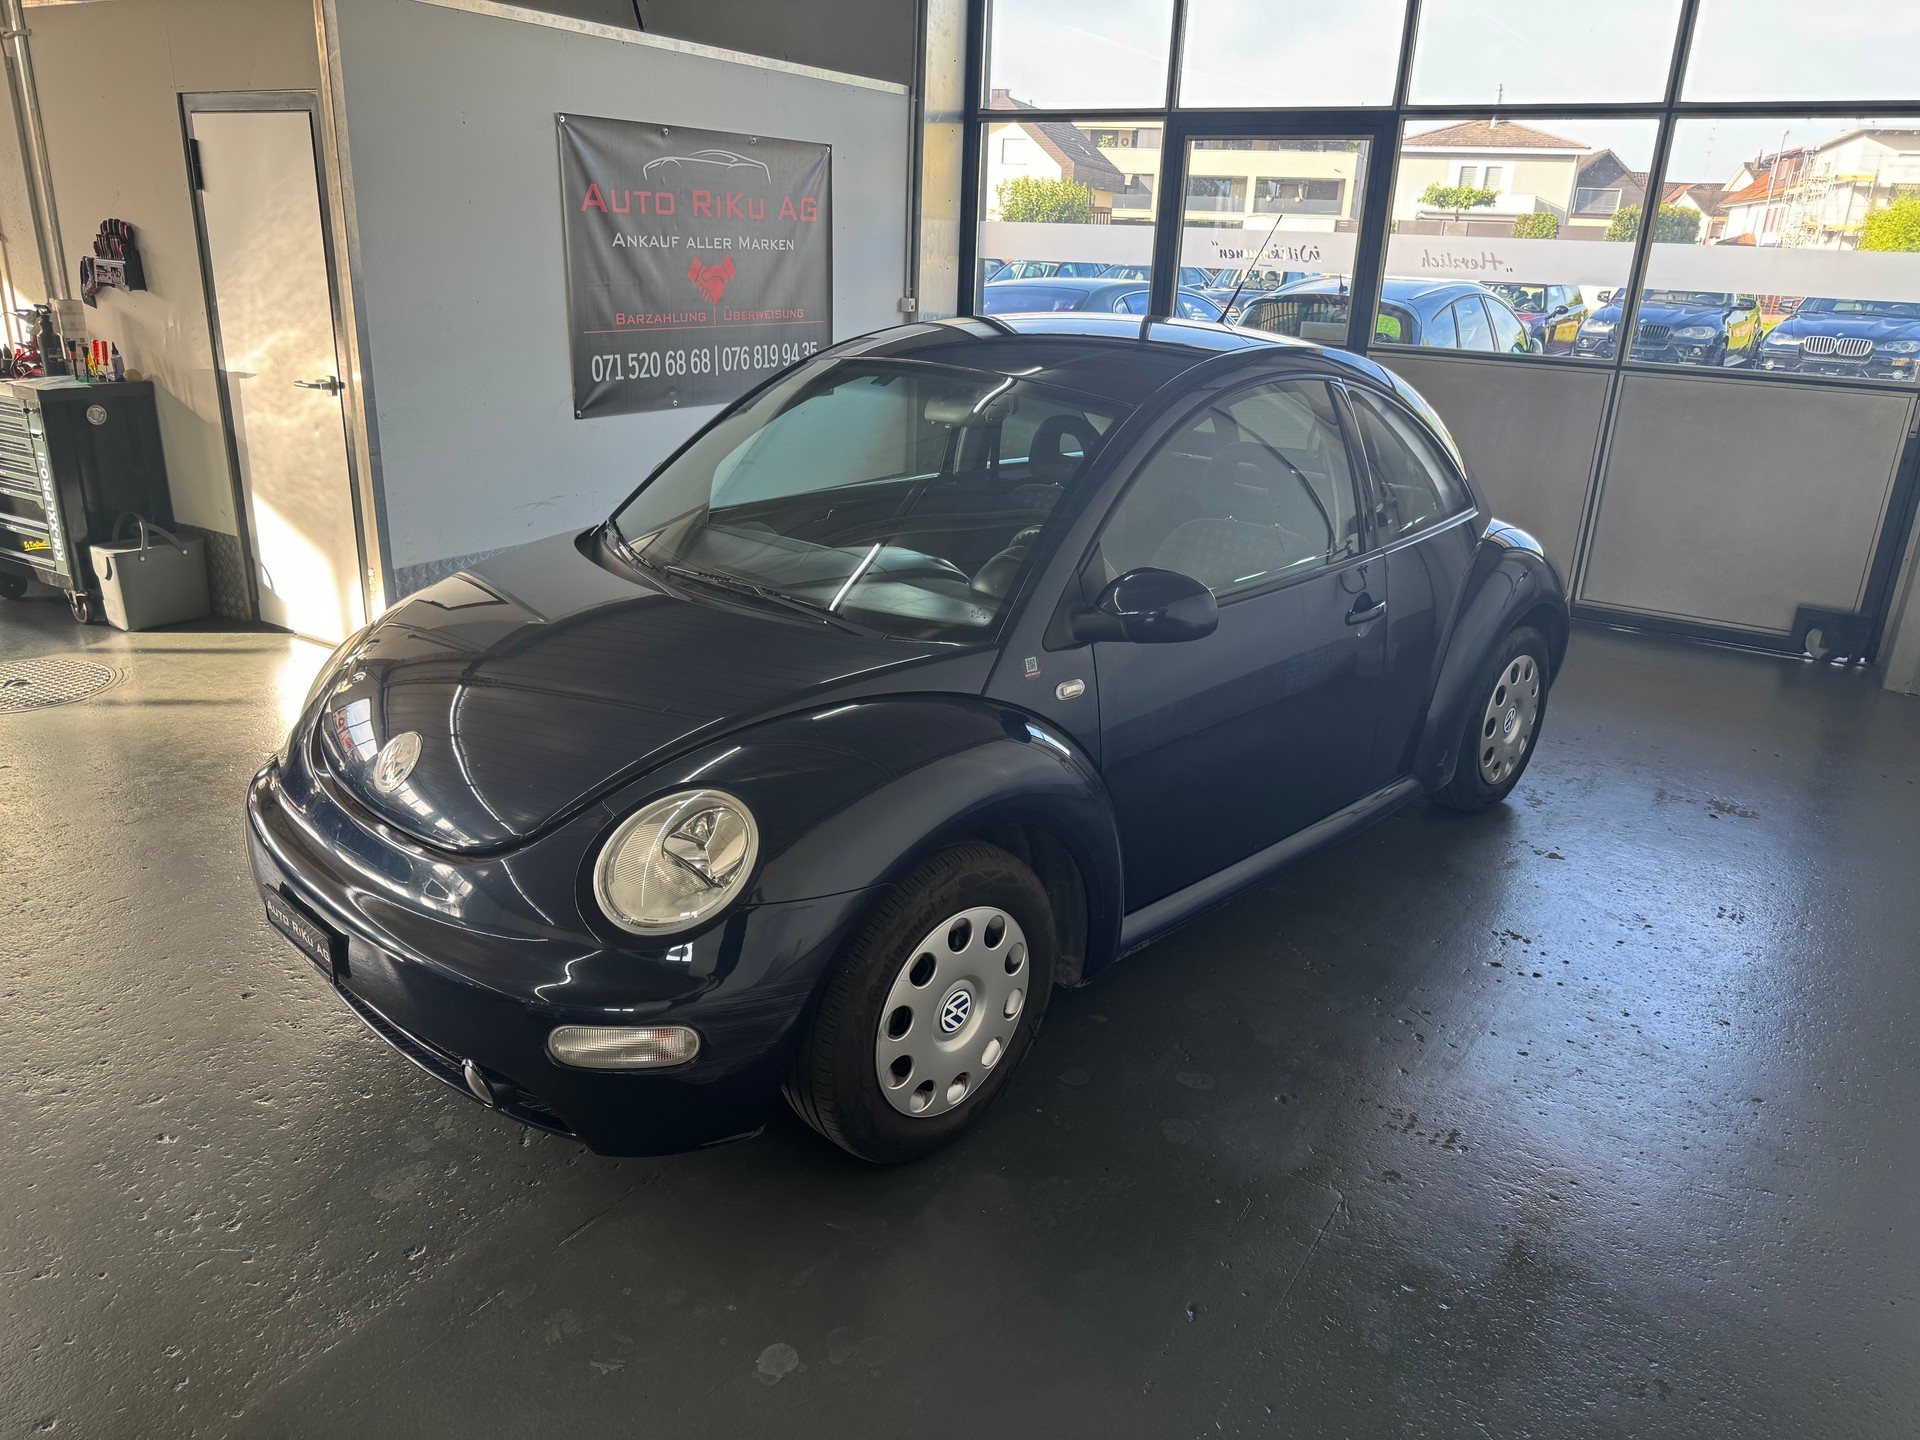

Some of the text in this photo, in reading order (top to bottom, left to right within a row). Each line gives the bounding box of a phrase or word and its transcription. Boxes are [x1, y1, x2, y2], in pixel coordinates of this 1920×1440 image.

[778, 196, 818, 222] AG
[591, 354, 625, 383] 071
[628, 351, 661, 380] 520
[665, 350, 686, 377] 68
[690, 348, 711, 375] 68
[722, 346, 750, 372] 076
[753, 344, 779, 369] 819
[782, 342, 800, 367] 94
[267, 900, 290, 927] AUTO
